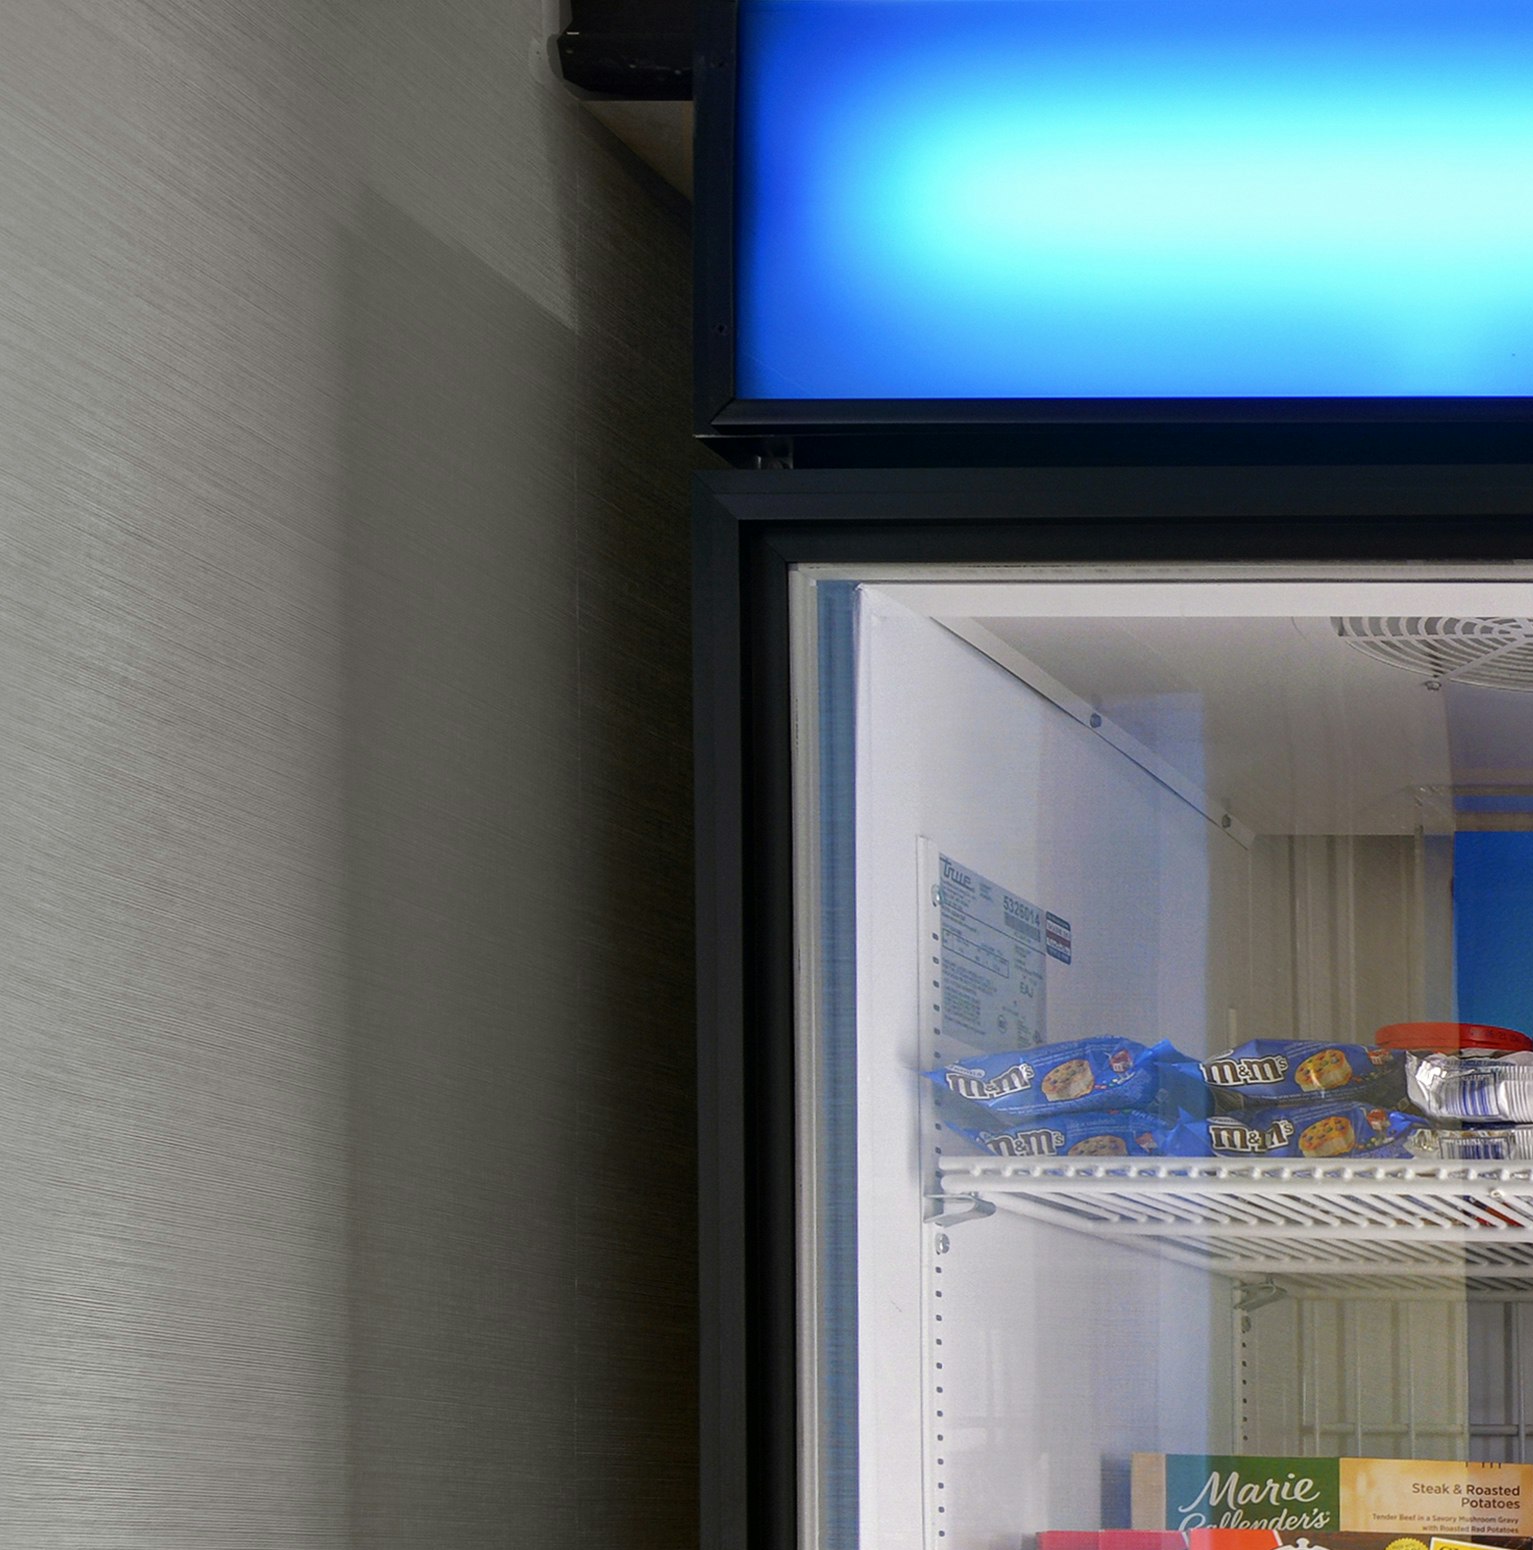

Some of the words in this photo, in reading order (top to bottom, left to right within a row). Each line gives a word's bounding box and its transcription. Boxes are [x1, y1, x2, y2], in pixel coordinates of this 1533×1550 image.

[1178, 1471, 1321, 1513] Marie
[1412, 1483, 1449, 1494] Steak
[1453, 1483, 1462, 1494] &
[1466, 1485, 1520, 1496] Roasted
[1461, 1498, 1520, 1509] Potatoes
